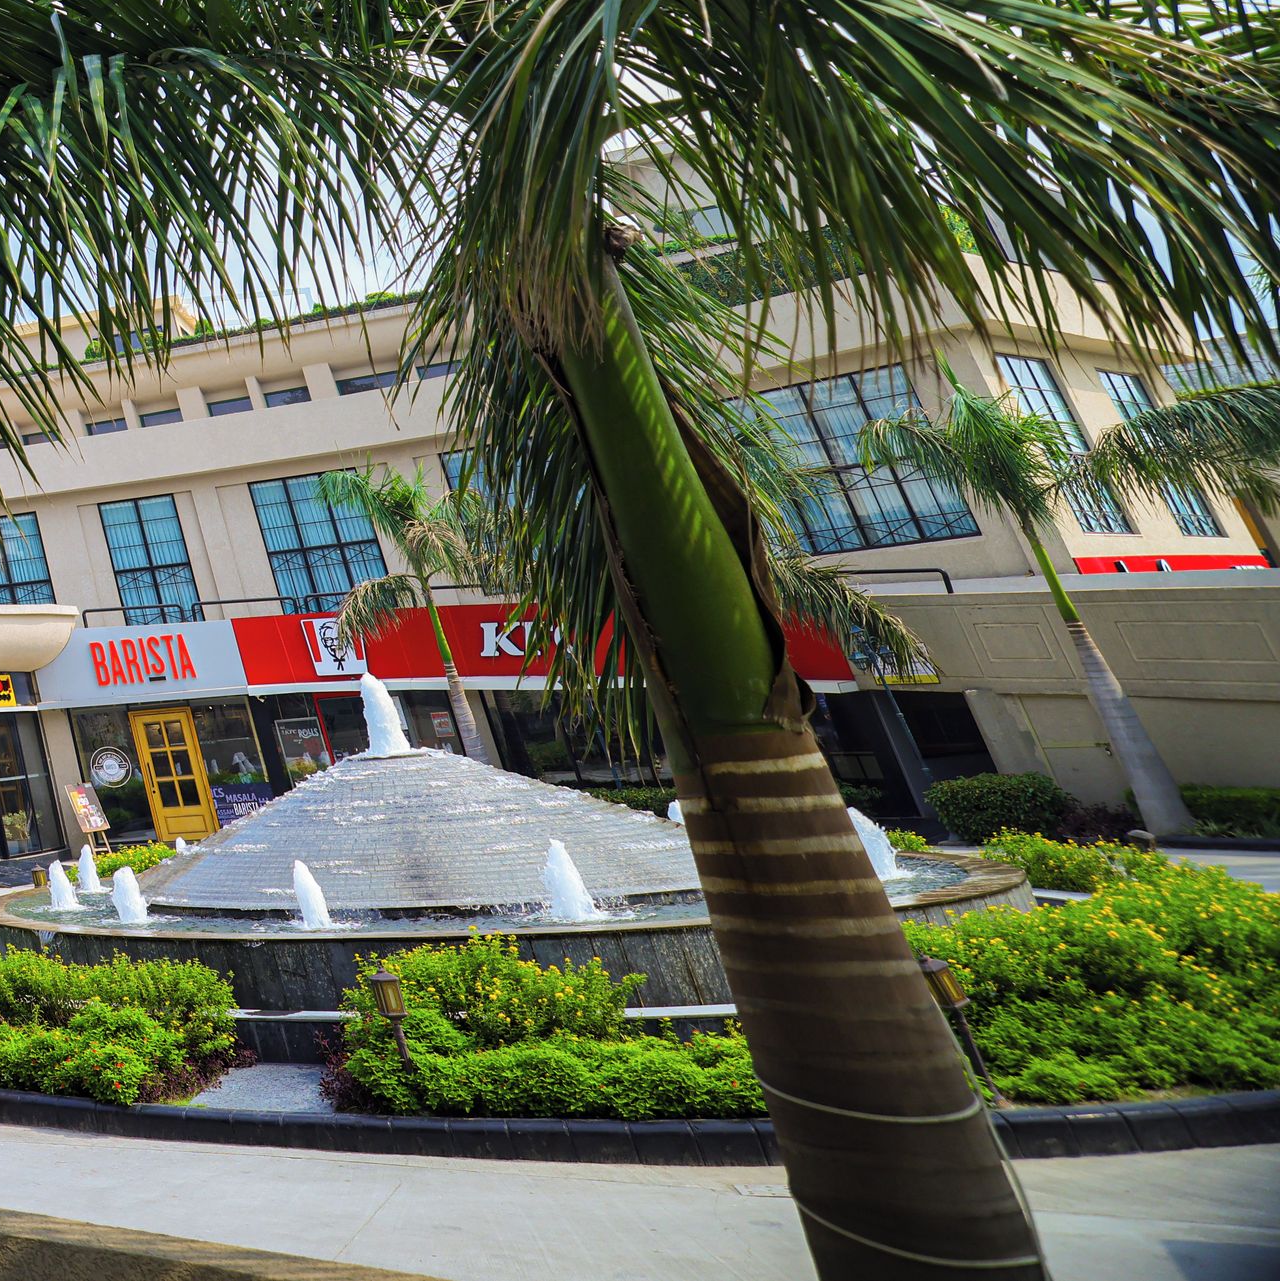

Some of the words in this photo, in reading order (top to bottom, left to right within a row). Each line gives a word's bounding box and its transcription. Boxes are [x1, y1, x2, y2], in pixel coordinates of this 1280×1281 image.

[89, 633, 197, 687] BARISTA
[297, 727, 319, 739] ROLLS
[225, 792, 258, 804] MASALA
